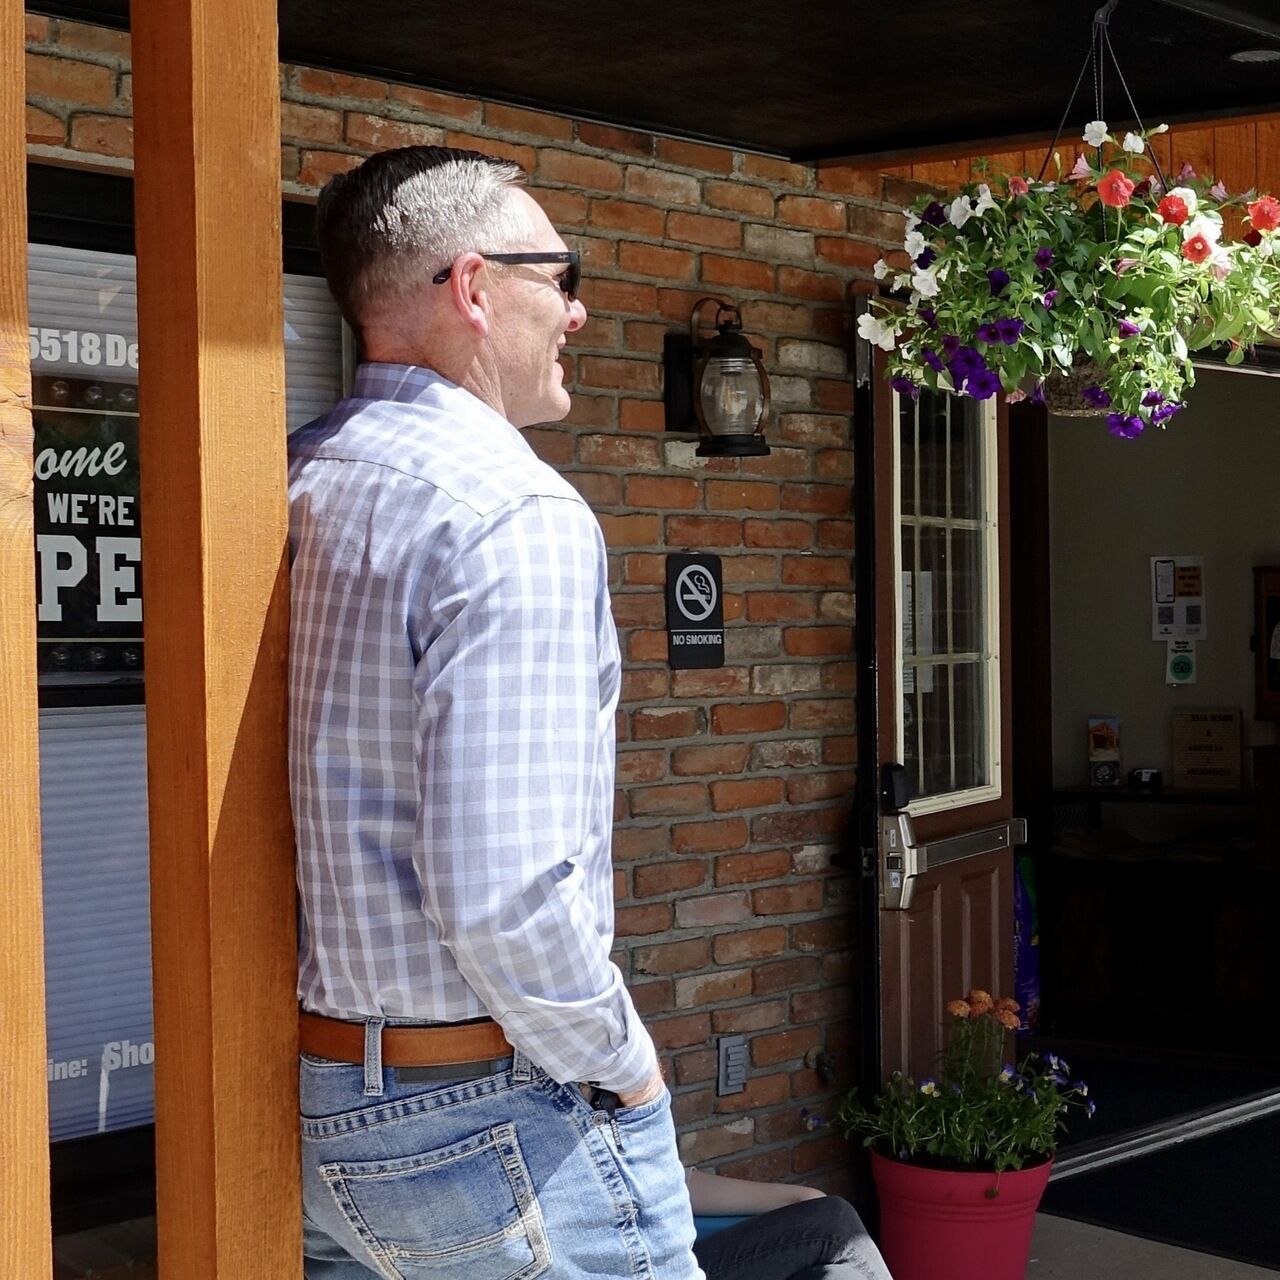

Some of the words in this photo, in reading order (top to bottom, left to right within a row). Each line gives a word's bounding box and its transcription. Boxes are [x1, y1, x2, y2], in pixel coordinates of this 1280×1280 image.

[35, 441, 128, 481] ome
[47, 492, 135, 526] WE'RE
[36, 534, 143, 622] PE
[673, 635, 685, 645] NO
[686, 634, 722, 645] SMOKING
